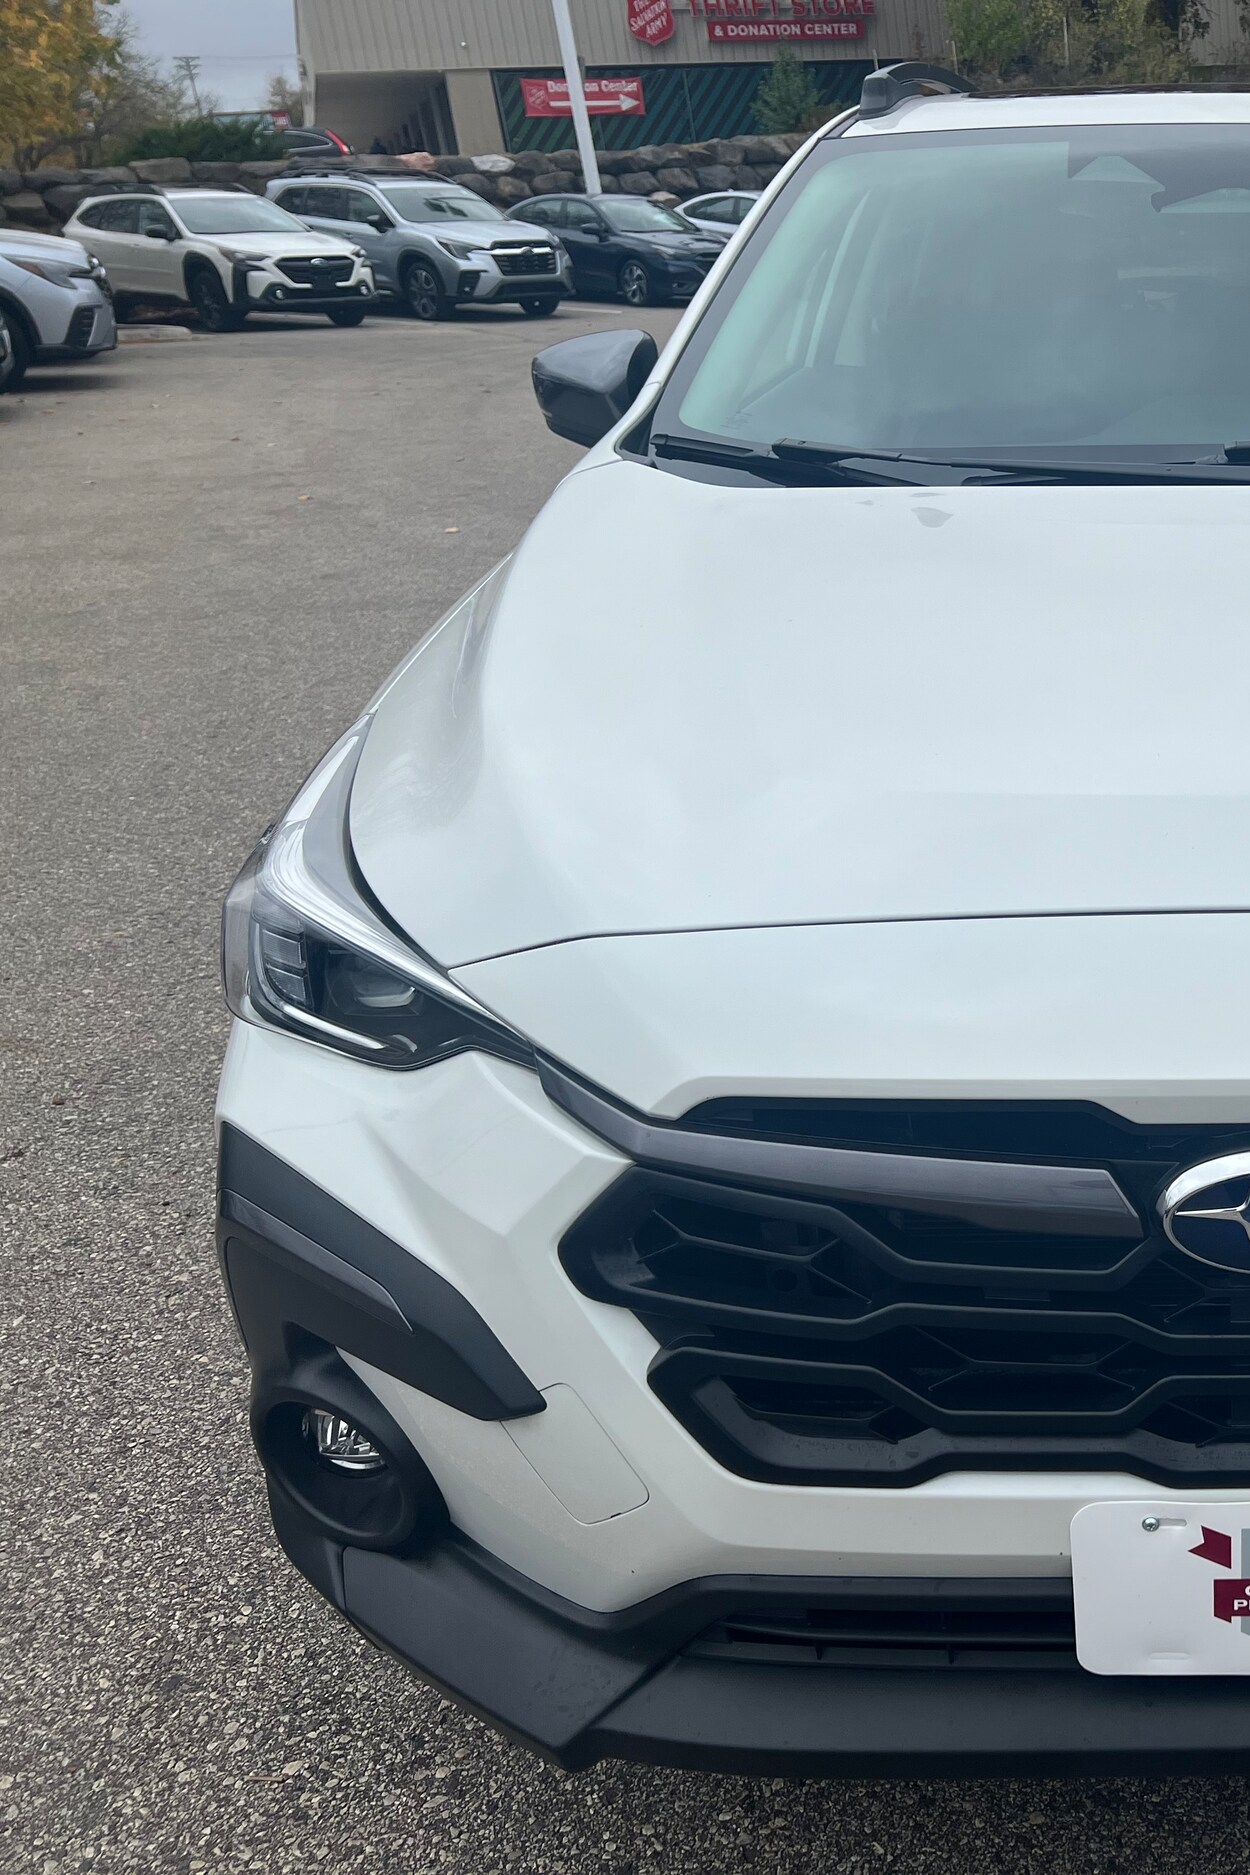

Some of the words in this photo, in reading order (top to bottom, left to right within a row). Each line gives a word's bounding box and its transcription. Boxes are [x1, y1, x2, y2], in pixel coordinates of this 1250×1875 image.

[630, 0, 668, 31] SALVATION
[689, 0, 780, 17] THRIFT
[791, 0, 876, 16] STORE
[646, 12, 668, 38] ARMY
[714, 25, 724, 36] &
[727, 24, 801, 36] DONATION
[804, 23, 857, 35] CENTER
[547, 81, 599, 93] Donon
[601, 80, 638, 92] Center
